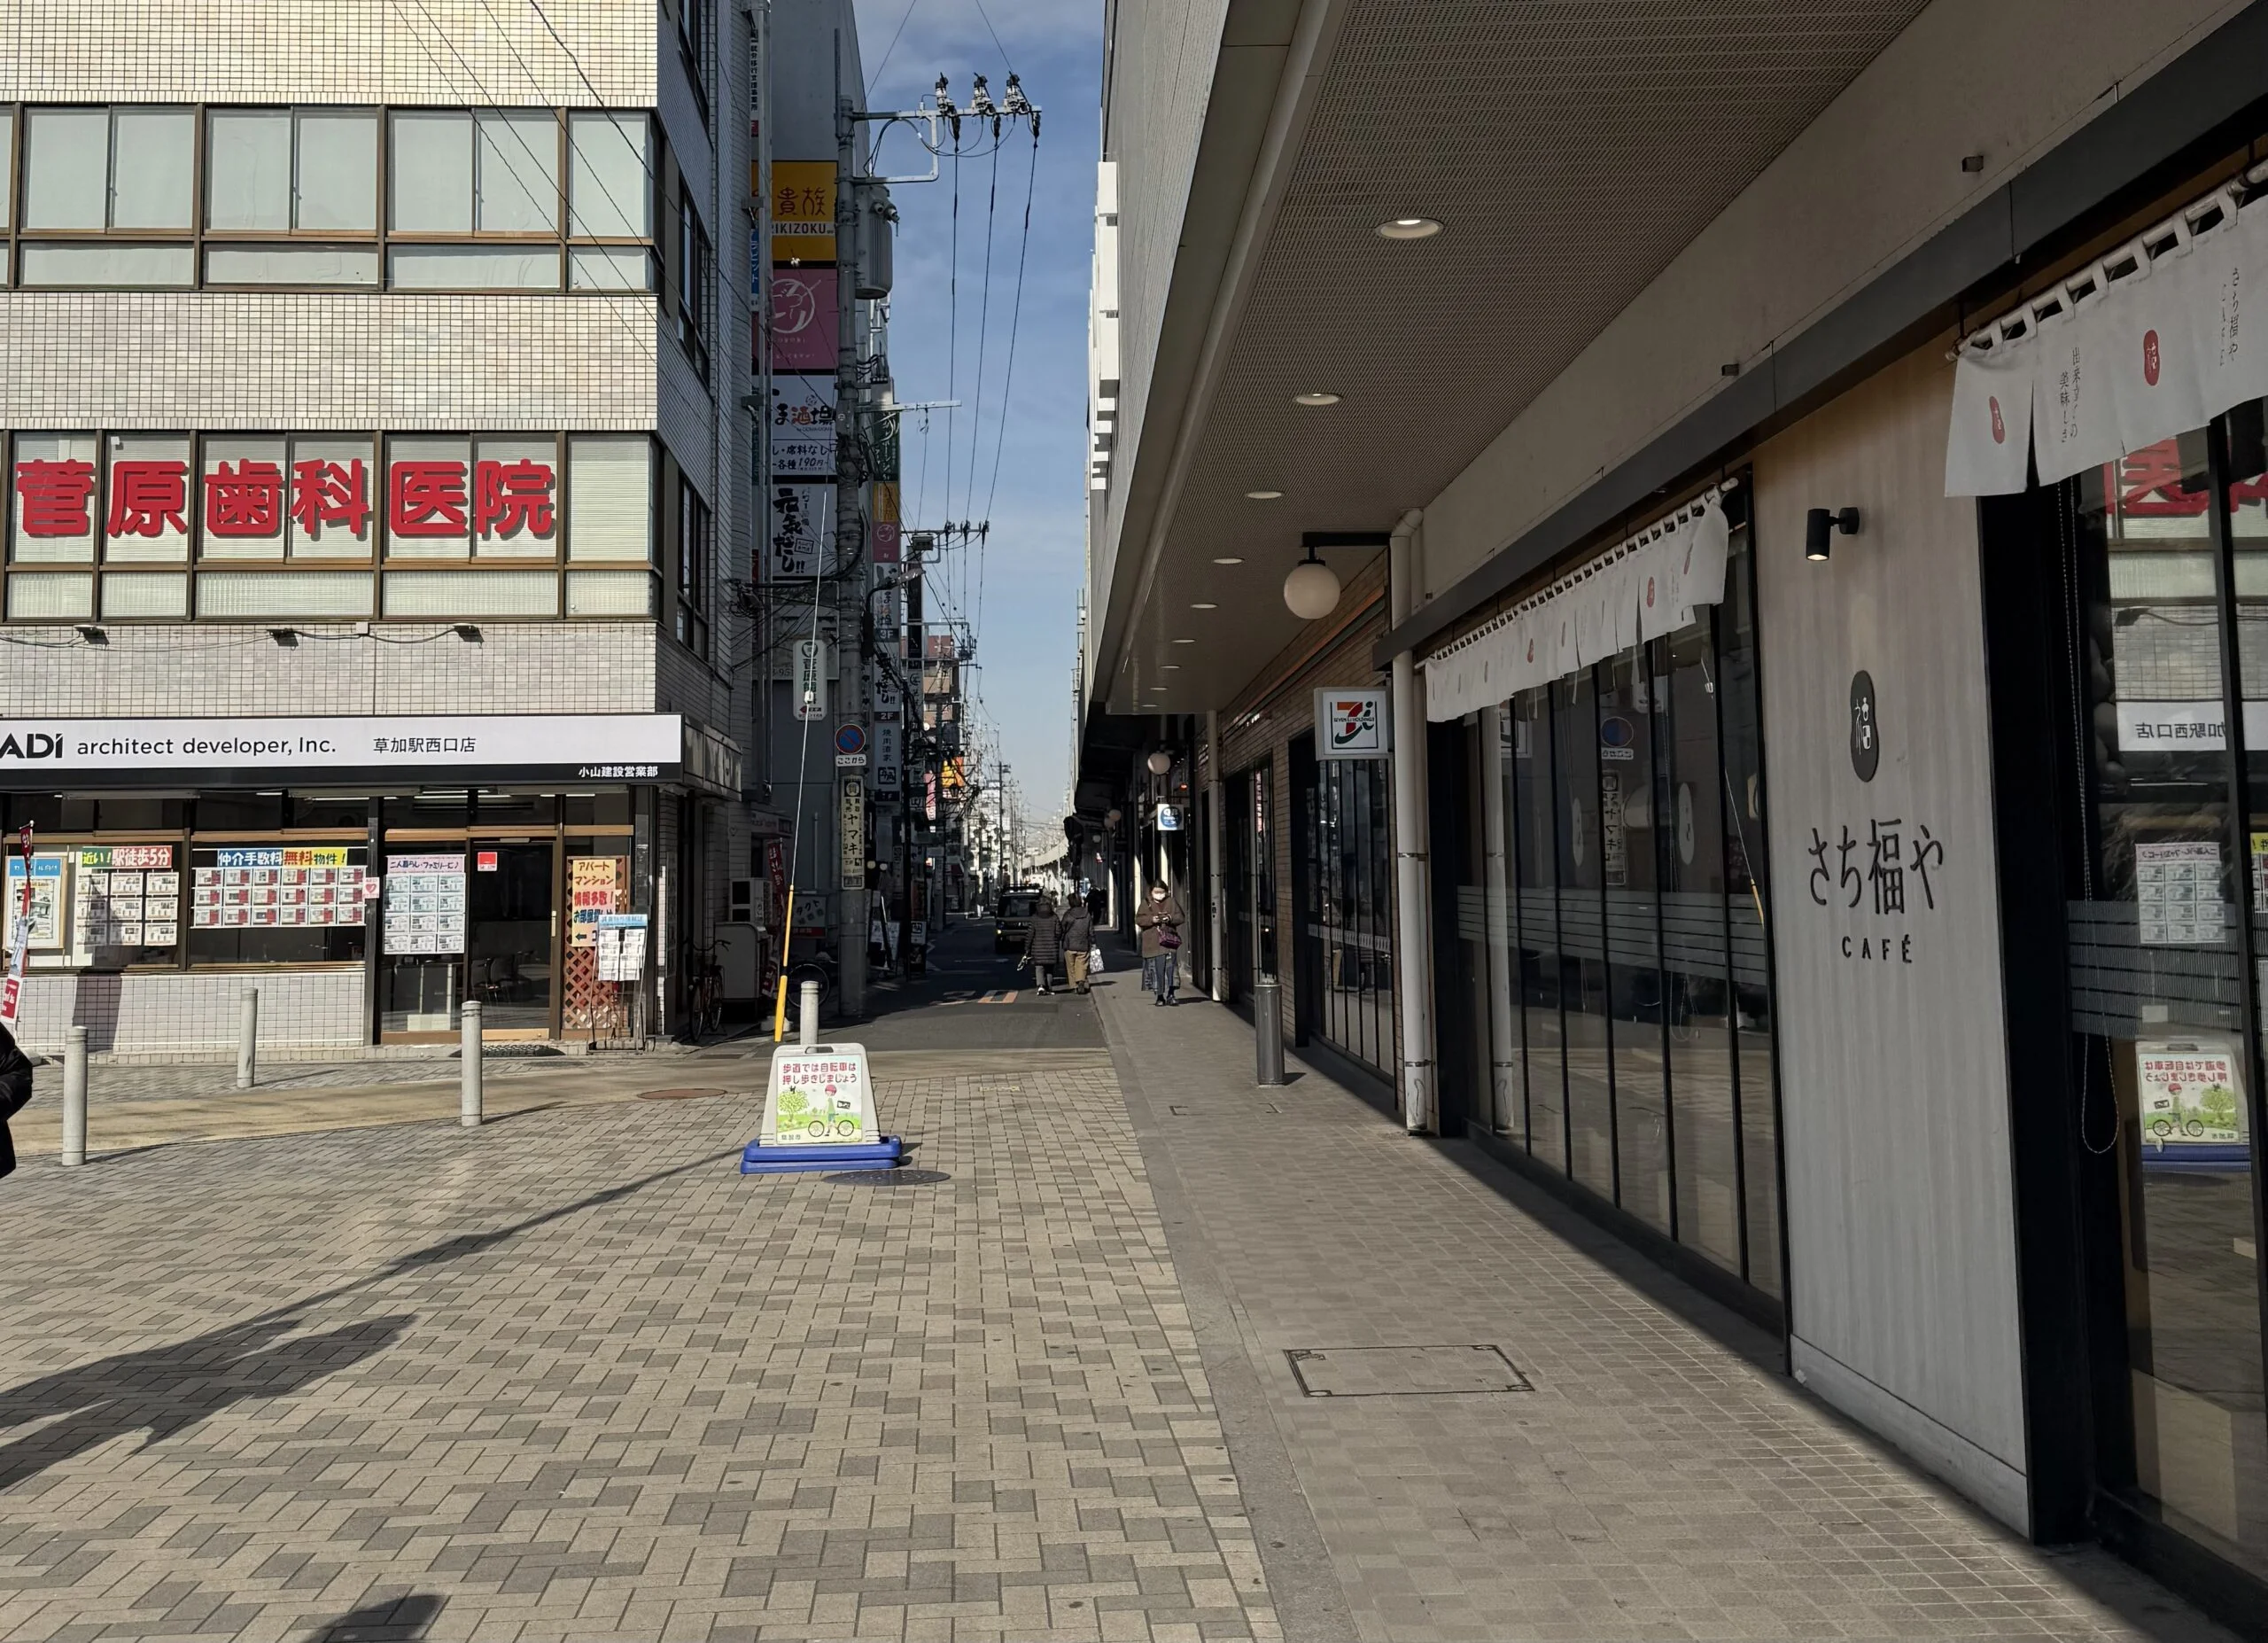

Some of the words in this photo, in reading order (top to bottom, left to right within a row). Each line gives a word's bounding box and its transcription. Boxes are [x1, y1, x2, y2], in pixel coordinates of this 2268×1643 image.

[752, 187, 826, 218] 貴族
[772, 223, 826, 234] IKIZOKU
[16, 458, 556, 537] 菅原歯科医院
[880, 712, 894, 720] 2F
[77, 738, 175, 755] architect
[183, 737, 292, 756] developer,
[299, 737, 337, 753] Inc.
[373, 737, 477, 753] 草加駅西口店
[836, 756, 865, 765] ここから
[579, 766, 659, 778] 小山建設営業部
[848, 814, 858, 855] ヤマキ
[579, 860, 610, 871] アパート
[1808, 819, 1943, 915] さち福や
[575, 875, 614, 885] マンション
[1842, 934, 1912, 963] CAFÉ
[783, 1063, 857, 1073] 歩道では自転車は
[782, 1073, 857, 1086] 押し歩きしましょう
